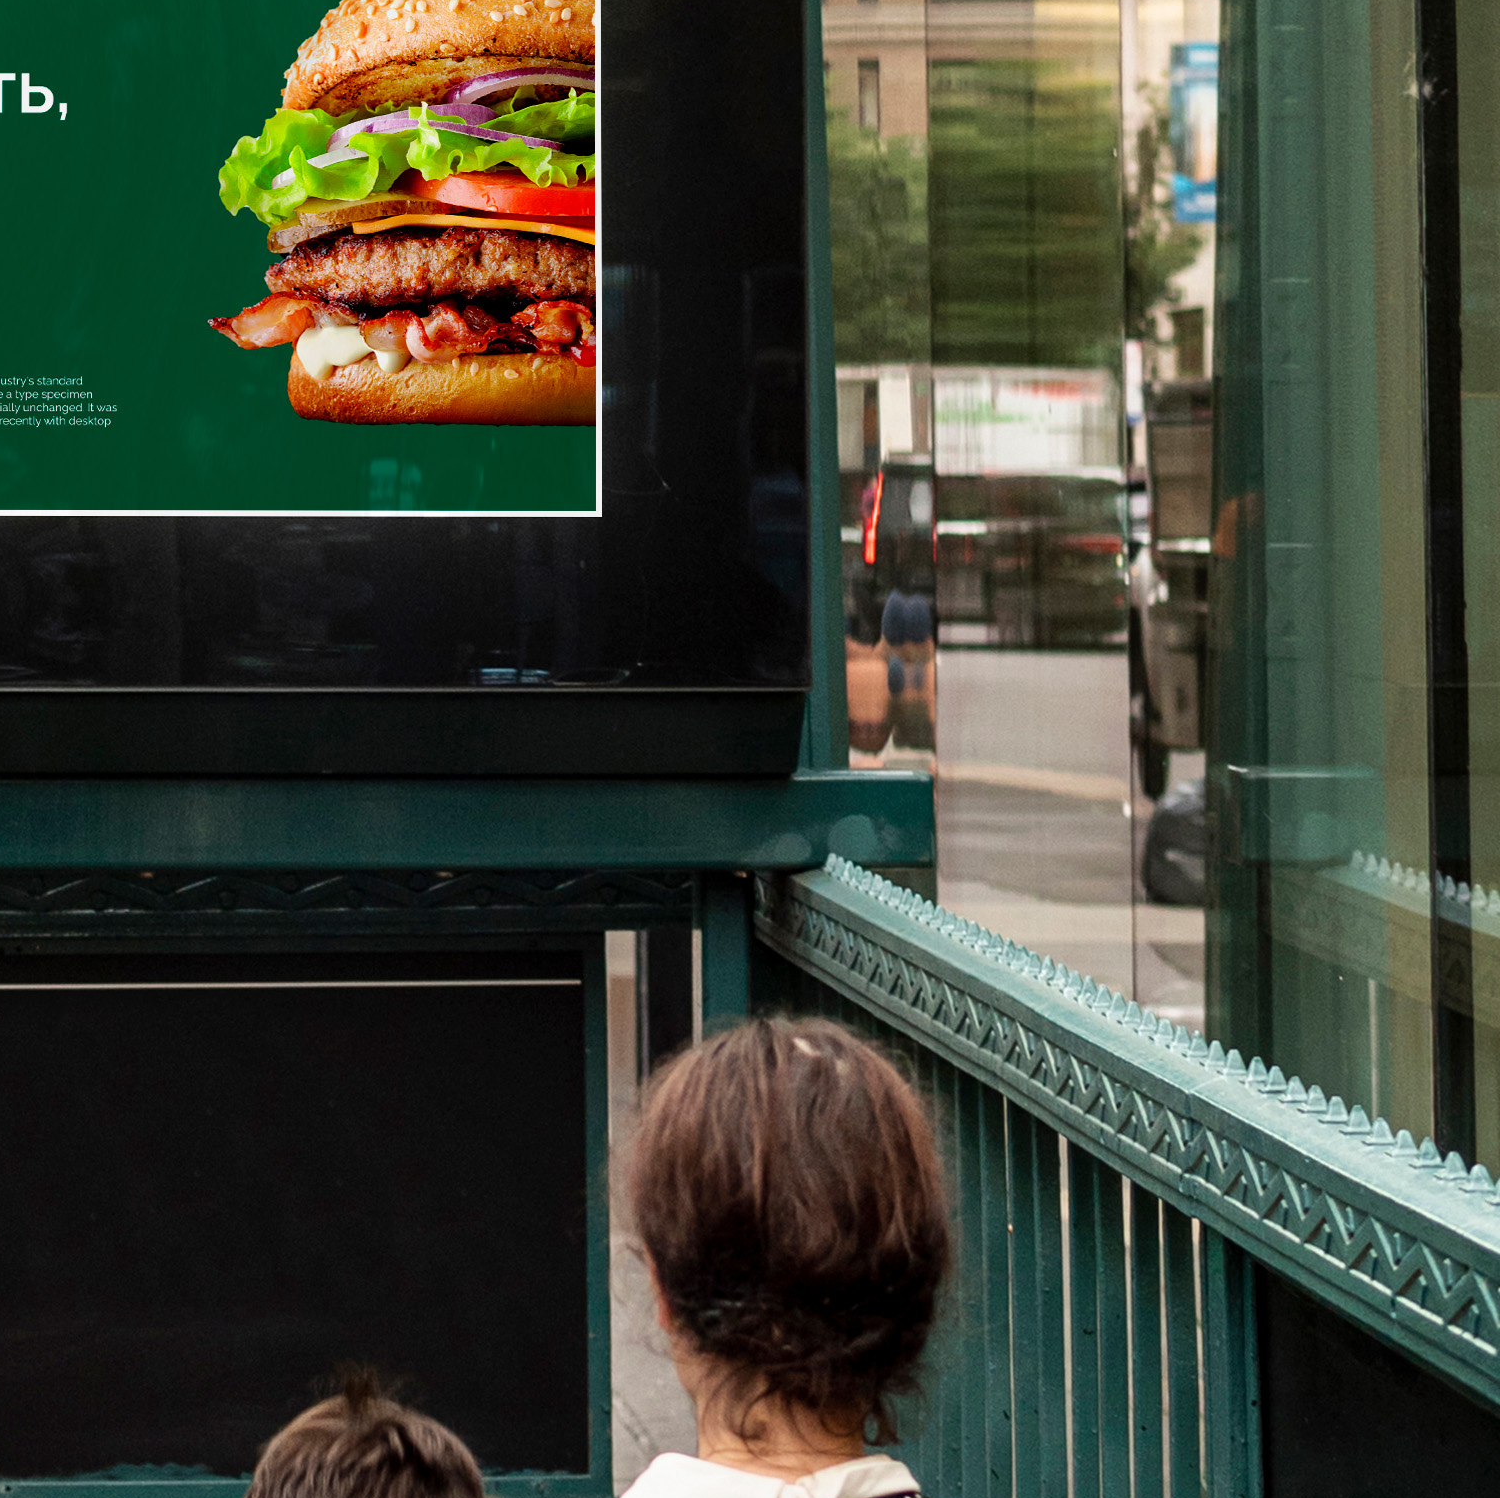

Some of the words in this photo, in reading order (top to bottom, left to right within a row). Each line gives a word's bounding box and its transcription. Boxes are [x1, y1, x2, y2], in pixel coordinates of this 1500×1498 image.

[36, 376, 82, 385] standard
[15, 390, 38, 400] type
[41, 392, 92, 402] specimen
[87, 403, 94, 411] It
[43, 414, 65, 425] with
[68, 416, 111, 427] desktop
